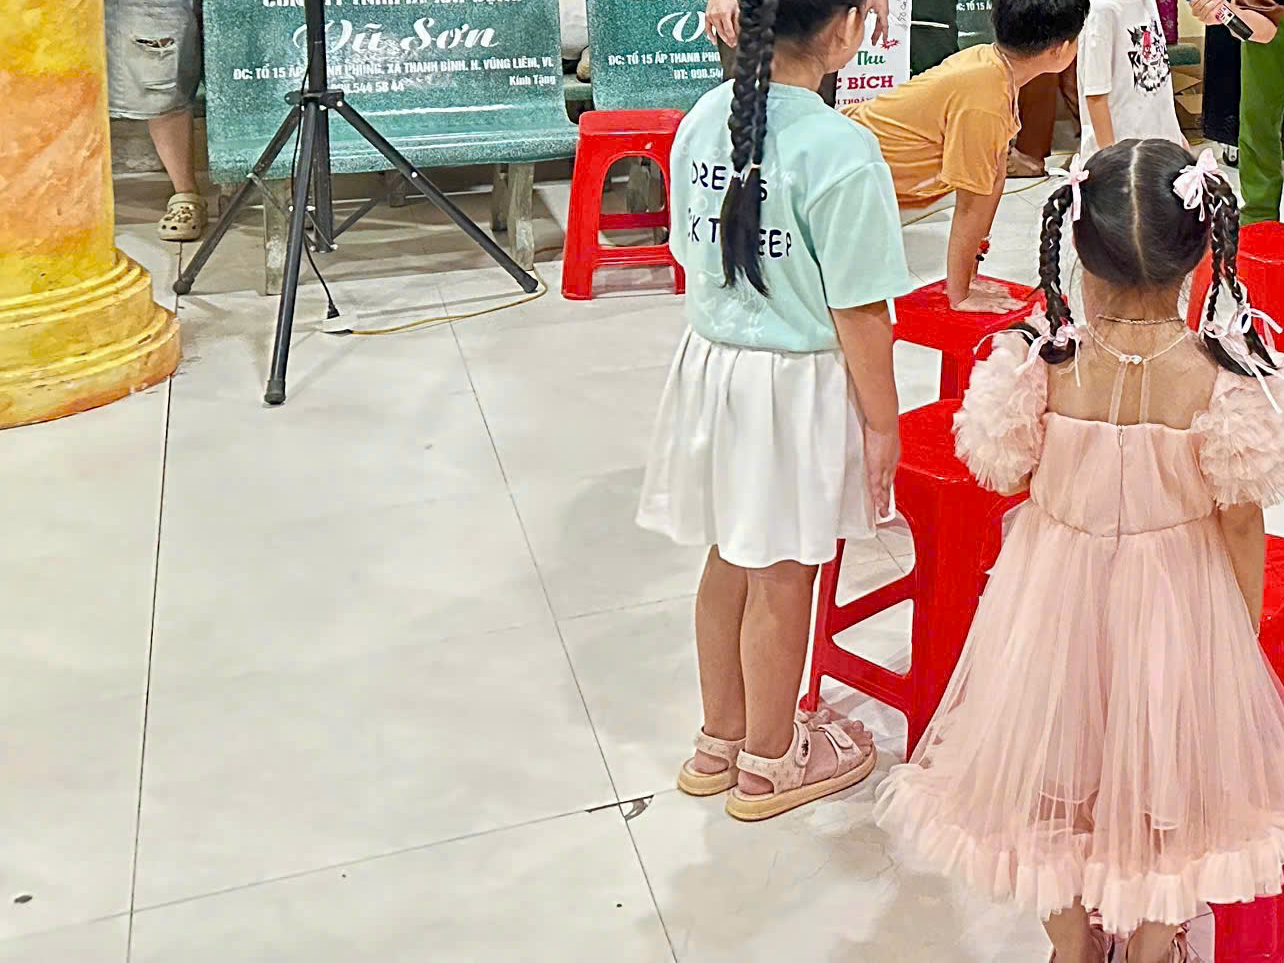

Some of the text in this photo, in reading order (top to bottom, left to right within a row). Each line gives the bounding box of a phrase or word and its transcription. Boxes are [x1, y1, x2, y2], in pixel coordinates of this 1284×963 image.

[400, 17, 500, 51] Sơn
[641, 54, 653, 64] 15
[669, 52, 700, 63] THANH
[272, 68, 284, 78] 15
[405, 60, 438, 73] THANH
[509, 76, 532, 86] Kính
[848, 73, 894, 90] BÍCH
